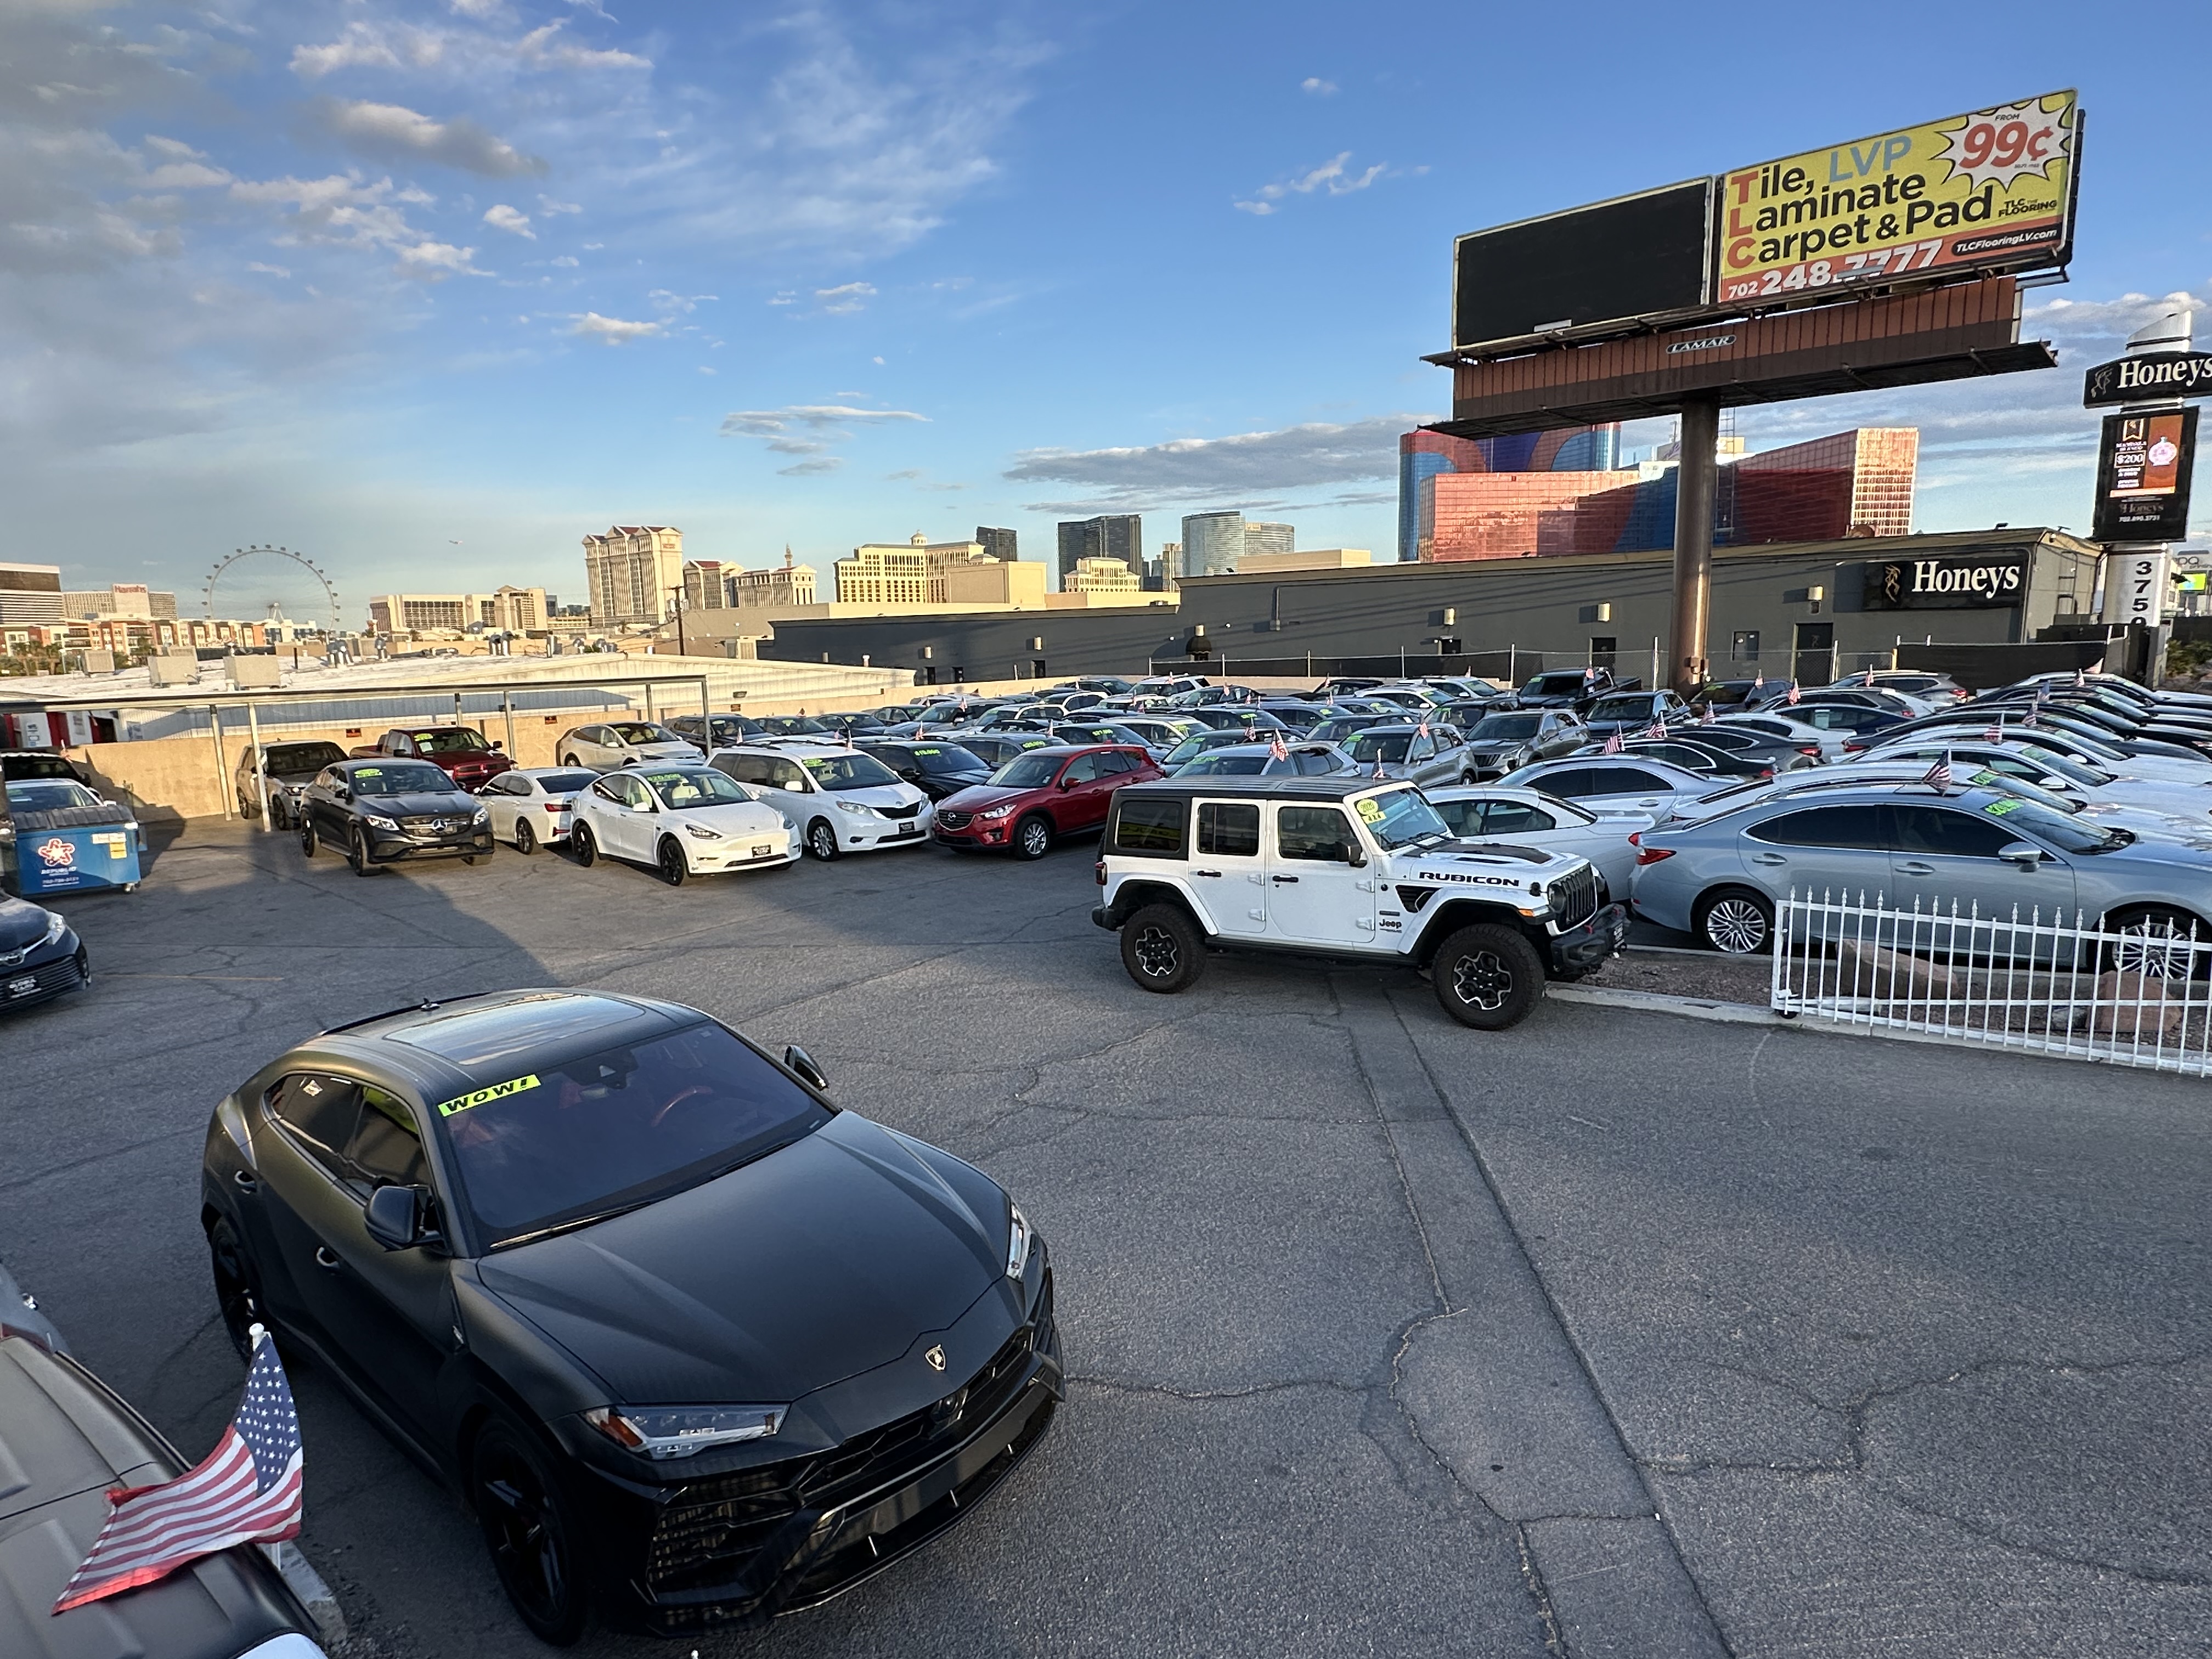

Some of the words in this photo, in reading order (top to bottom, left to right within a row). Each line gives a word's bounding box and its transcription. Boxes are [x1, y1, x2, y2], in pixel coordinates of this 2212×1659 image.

[1959, 121, 2054, 169] 99¢
[1731, 163, 1814, 205] Tile,
[1829, 135, 1912, 183] LVP
[1729, 173, 1926, 238] Laminate
[1999, 200, 2057, 217] FLOORING
[2004, 198, 2025, 208] TLC
[1728, 213, 1870, 268] Carpet
[1906, 184, 1994, 234] Pad
[1956, 229, 2057, 252] TLCFlooringLV.com
[1729, 280, 1759, 299] 702
[1671, 336, 1729, 353] LAMAR
[2117, 454, 2143, 464] $200
[1912, 561, 2021, 599] Honeys
[1419, 872, 1520, 887] RUBICON
[1379, 918, 1402, 929] Jeep
[446, 1078, 527, 1111] WOW!
